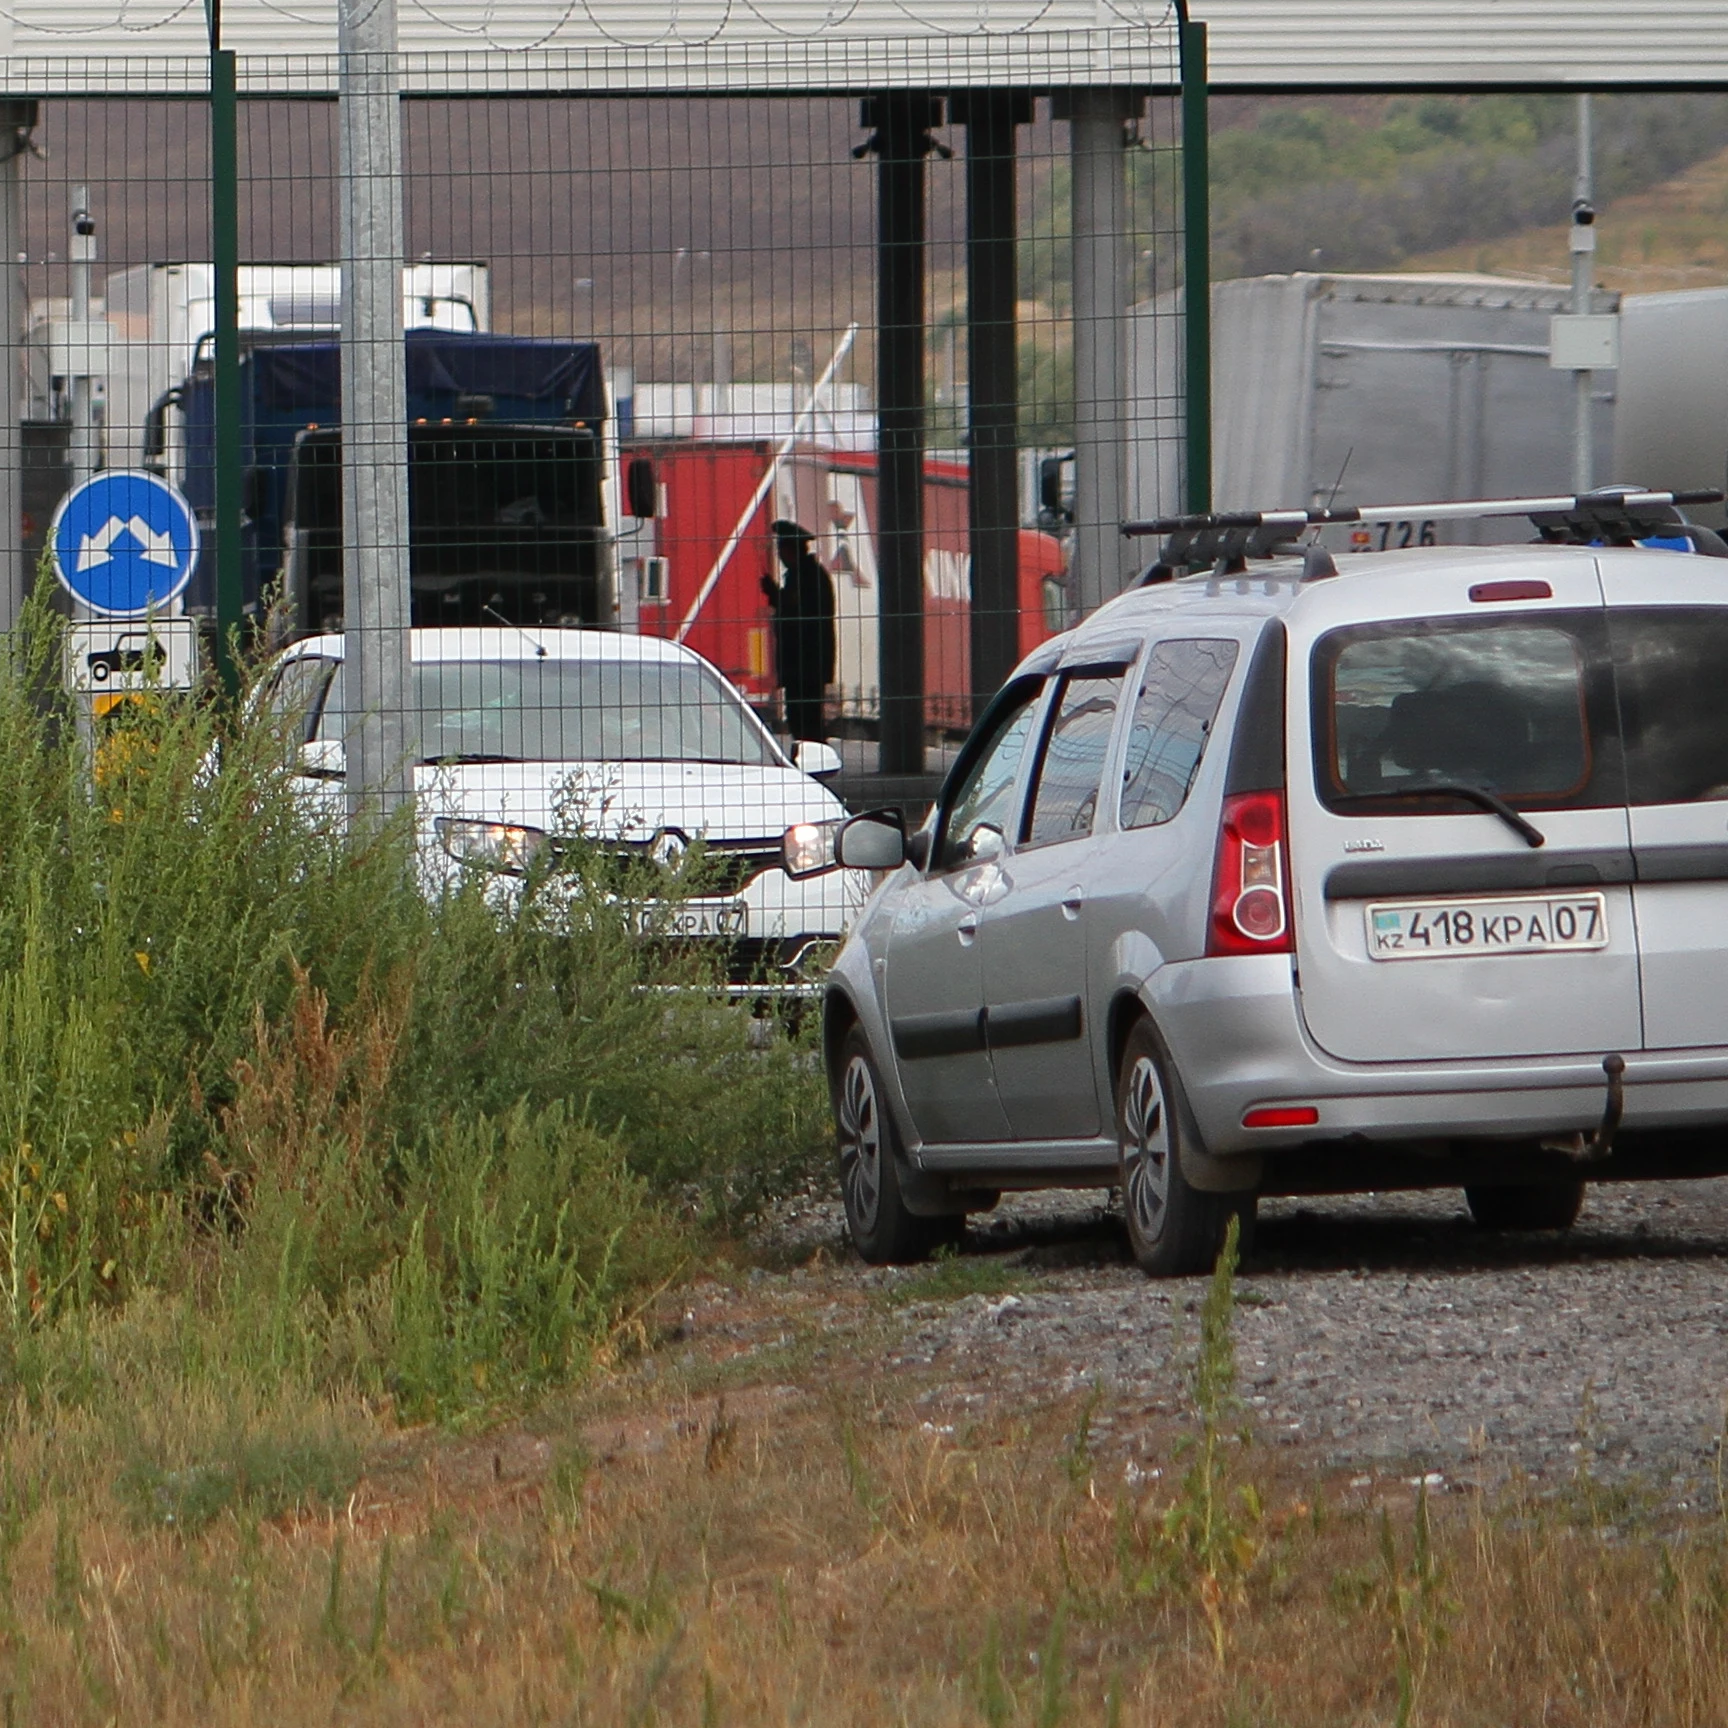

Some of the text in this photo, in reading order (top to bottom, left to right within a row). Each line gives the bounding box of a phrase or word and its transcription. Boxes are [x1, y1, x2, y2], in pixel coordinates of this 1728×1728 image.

[1376, 933, 1404, 949] KZ
[1409, 910, 1474, 946] 418
[1555, 905, 1598, 940] 07
